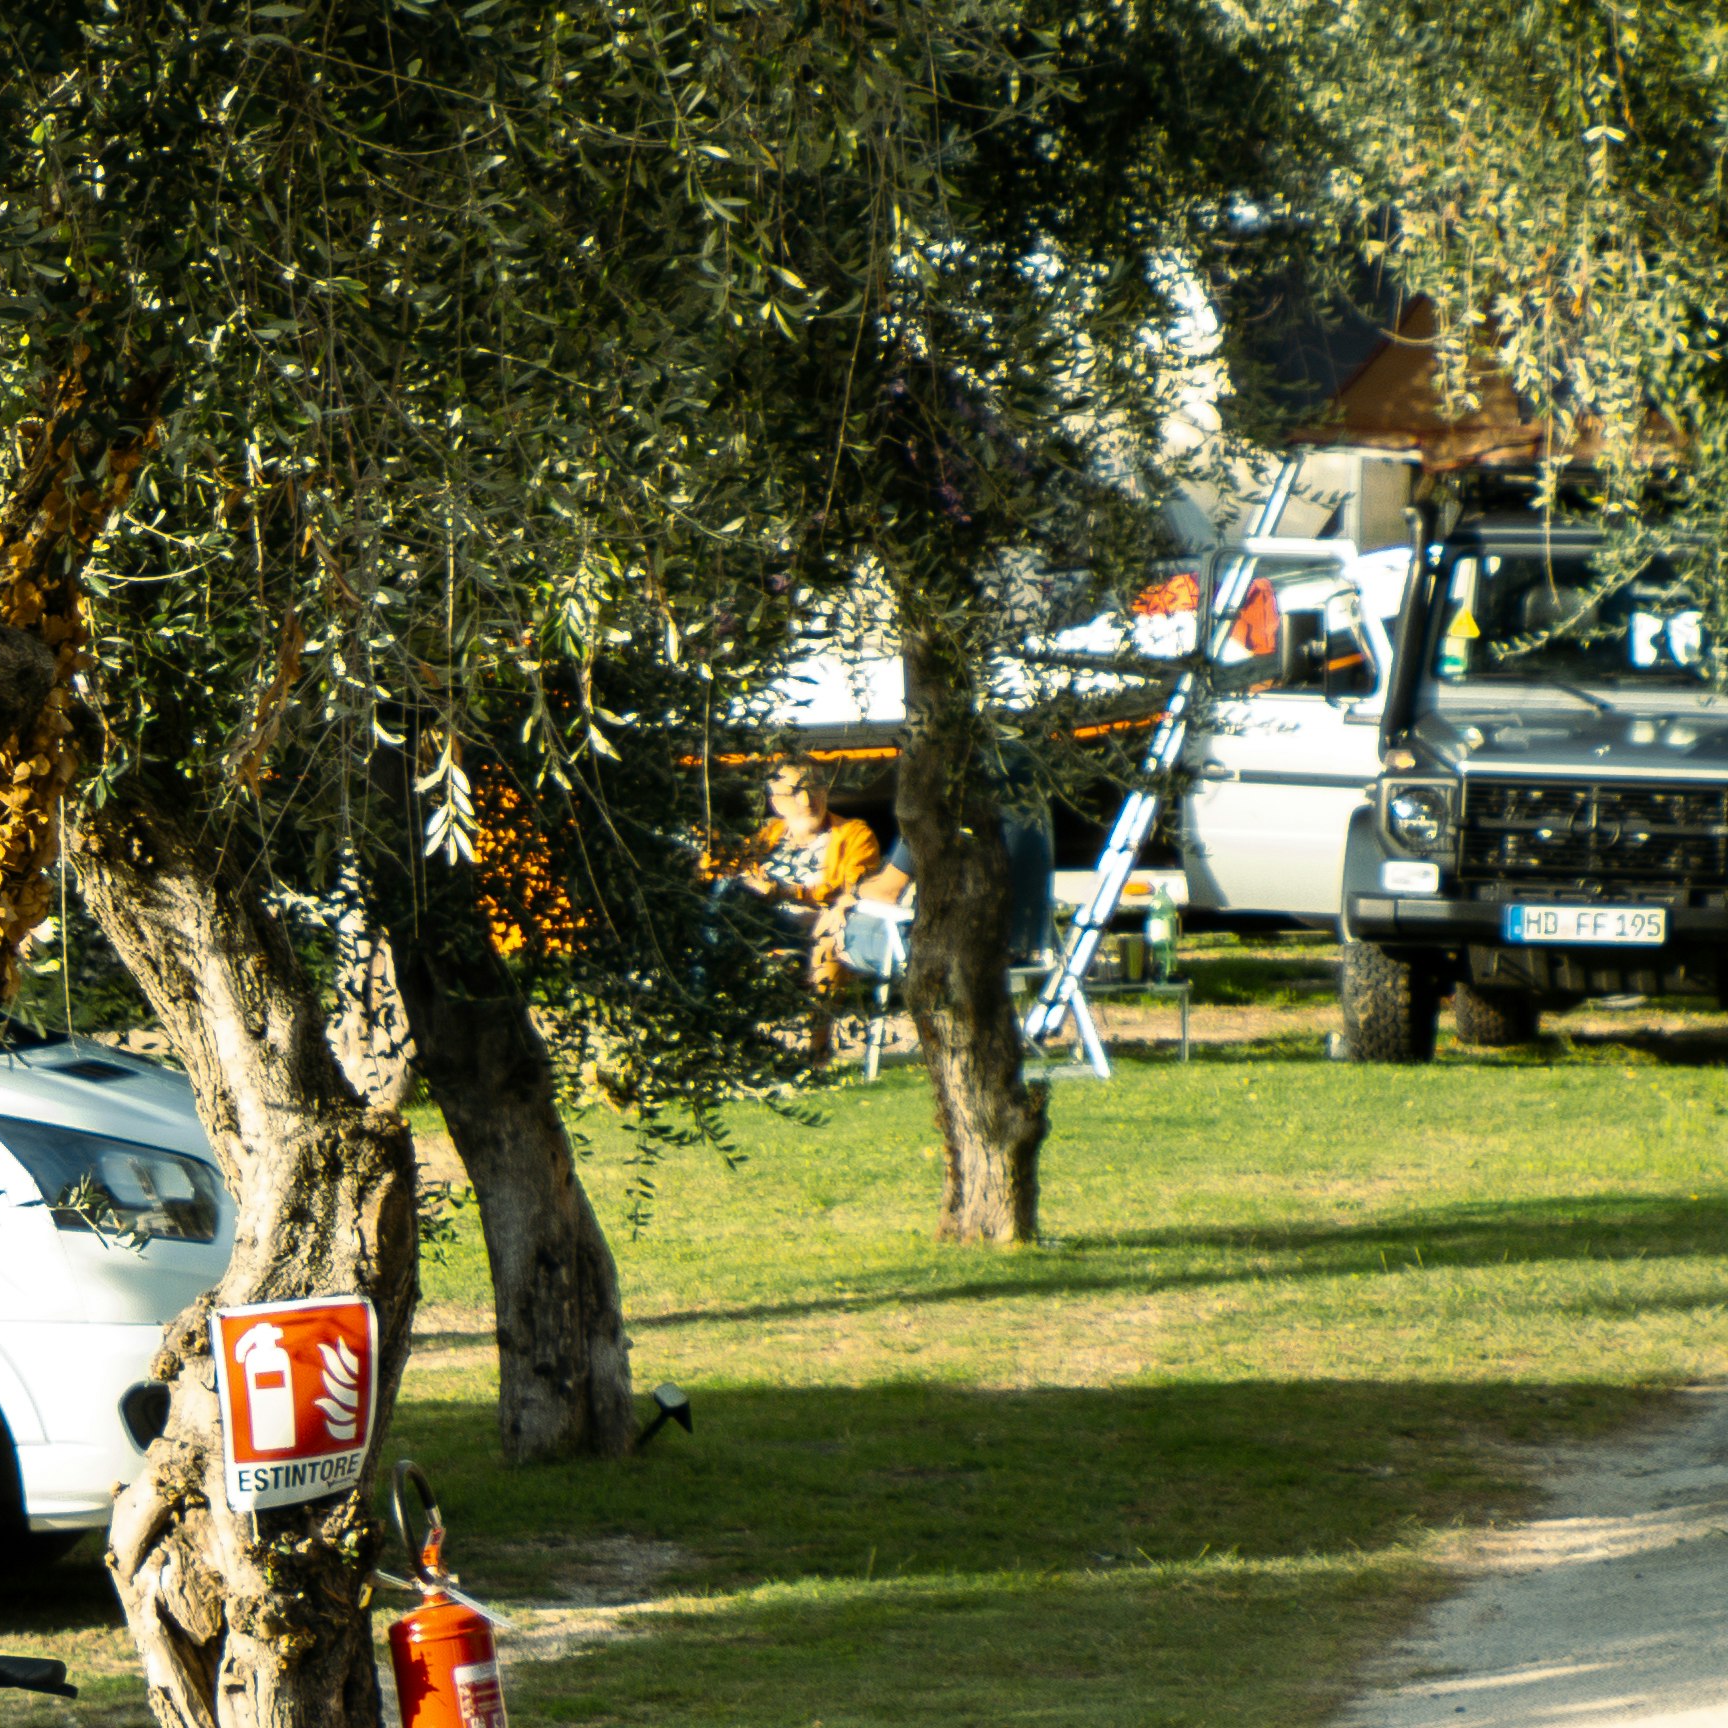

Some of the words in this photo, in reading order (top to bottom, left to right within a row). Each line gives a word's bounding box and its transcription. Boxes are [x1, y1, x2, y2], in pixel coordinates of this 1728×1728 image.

[1576, 912, 1608, 936] FF
[1615, 913, 1661, 937] 195
[238, 1452, 362, 1492] ESTINTORE
